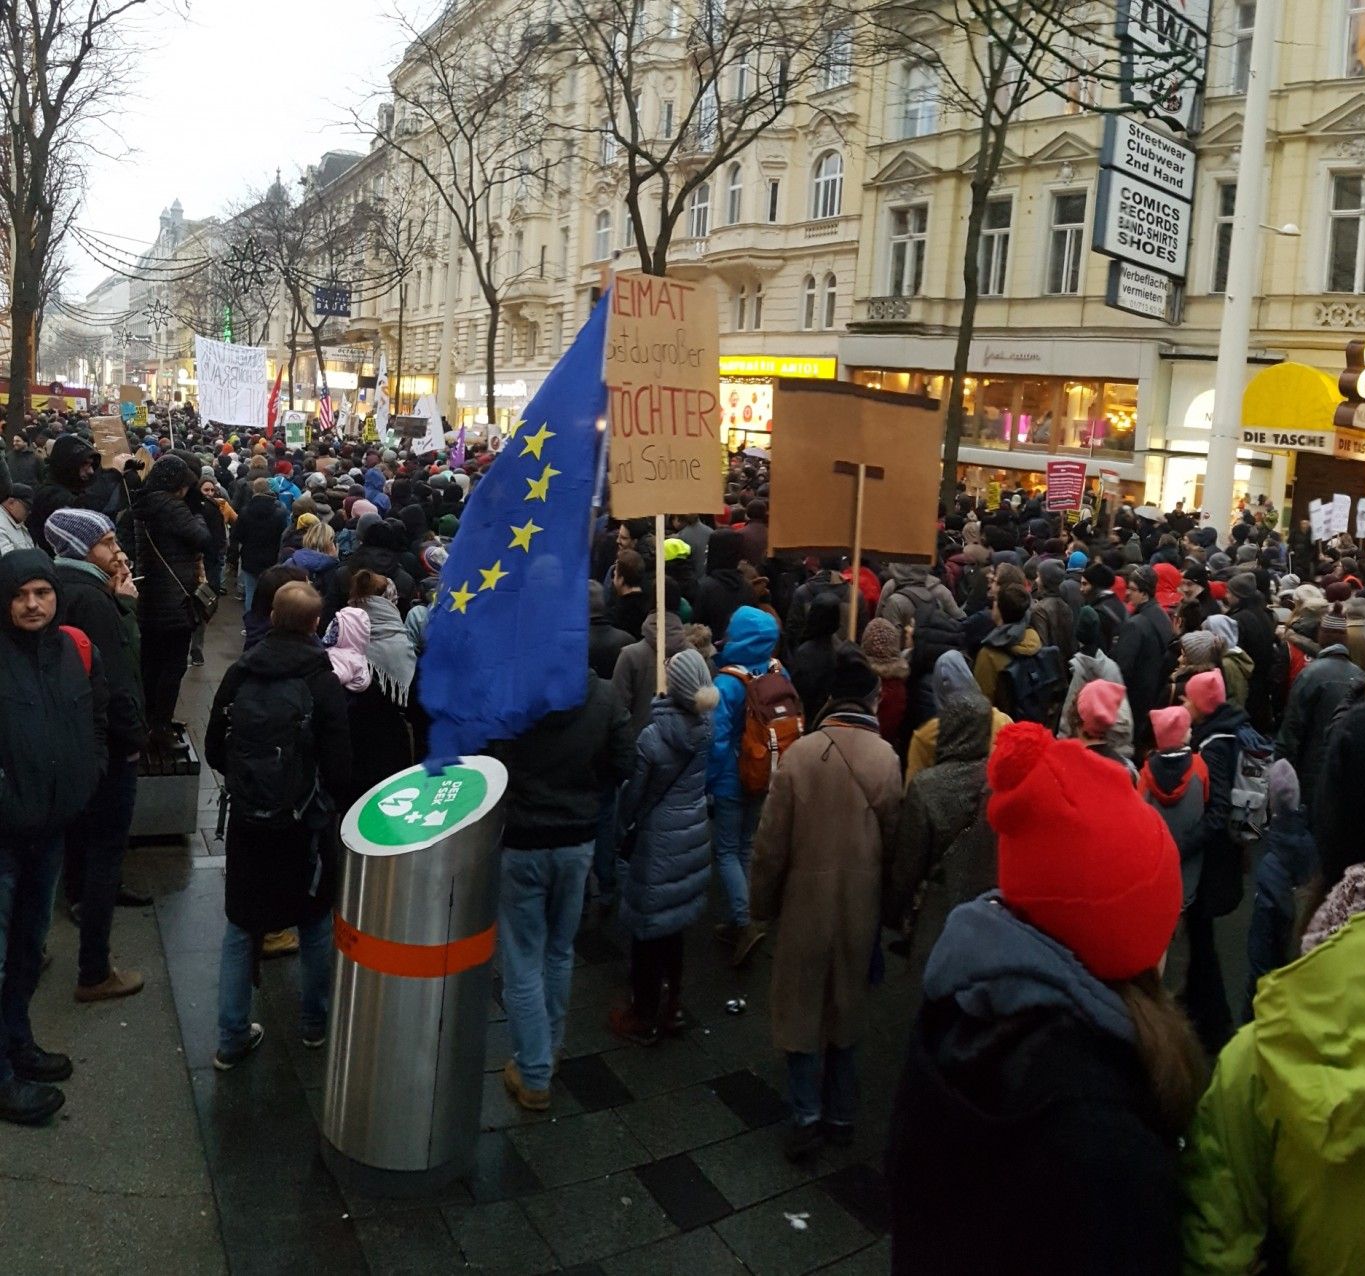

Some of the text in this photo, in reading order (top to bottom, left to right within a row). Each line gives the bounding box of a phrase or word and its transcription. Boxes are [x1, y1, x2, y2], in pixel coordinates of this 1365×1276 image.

[1127, 138, 1186, 174] Clubwear
[1128, 123, 1187, 161] Streetwear
[1126, 153, 1183, 189] 2nd Hand
[1119, 201, 1179, 236] RECORDS
[1121, 187, 1180, 222] COMICS
[1118, 216, 1178, 250] BAND-SHIRTS
[1118, 231, 1177, 263] SHOES
[1122, 284, 1163, 303] vermieten
[606, 381, 716, 439] TÖCHTER
[1243, 431, 1326, 447] DIE TASCHE
[641, 444, 701, 482] Söhne
[446, 780, 463, 802] DEFI
